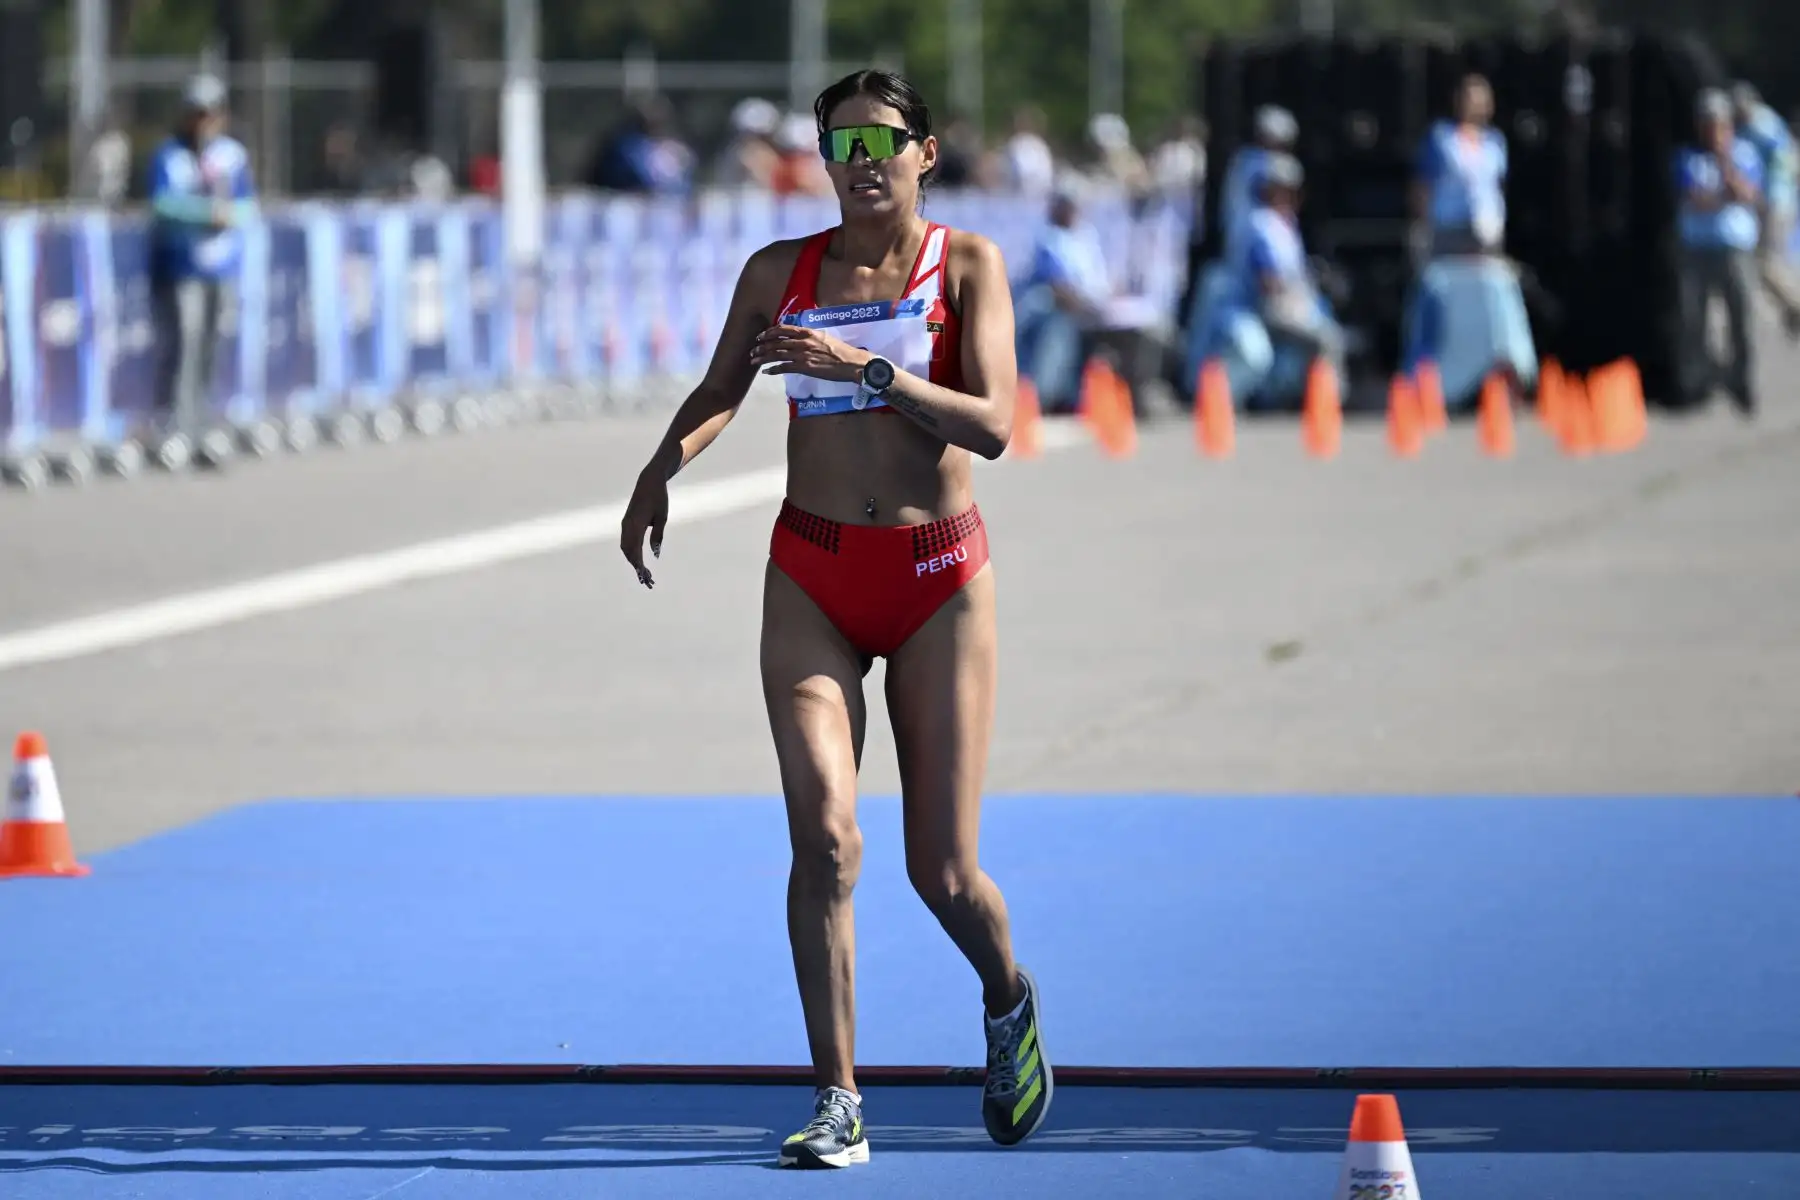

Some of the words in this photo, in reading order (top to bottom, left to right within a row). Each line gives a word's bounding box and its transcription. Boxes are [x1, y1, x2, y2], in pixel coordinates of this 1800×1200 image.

[808, 309, 852, 322] Santiago
[851, 306, 881, 319] 2023
[915, 545, 968, 577] PERÚ
